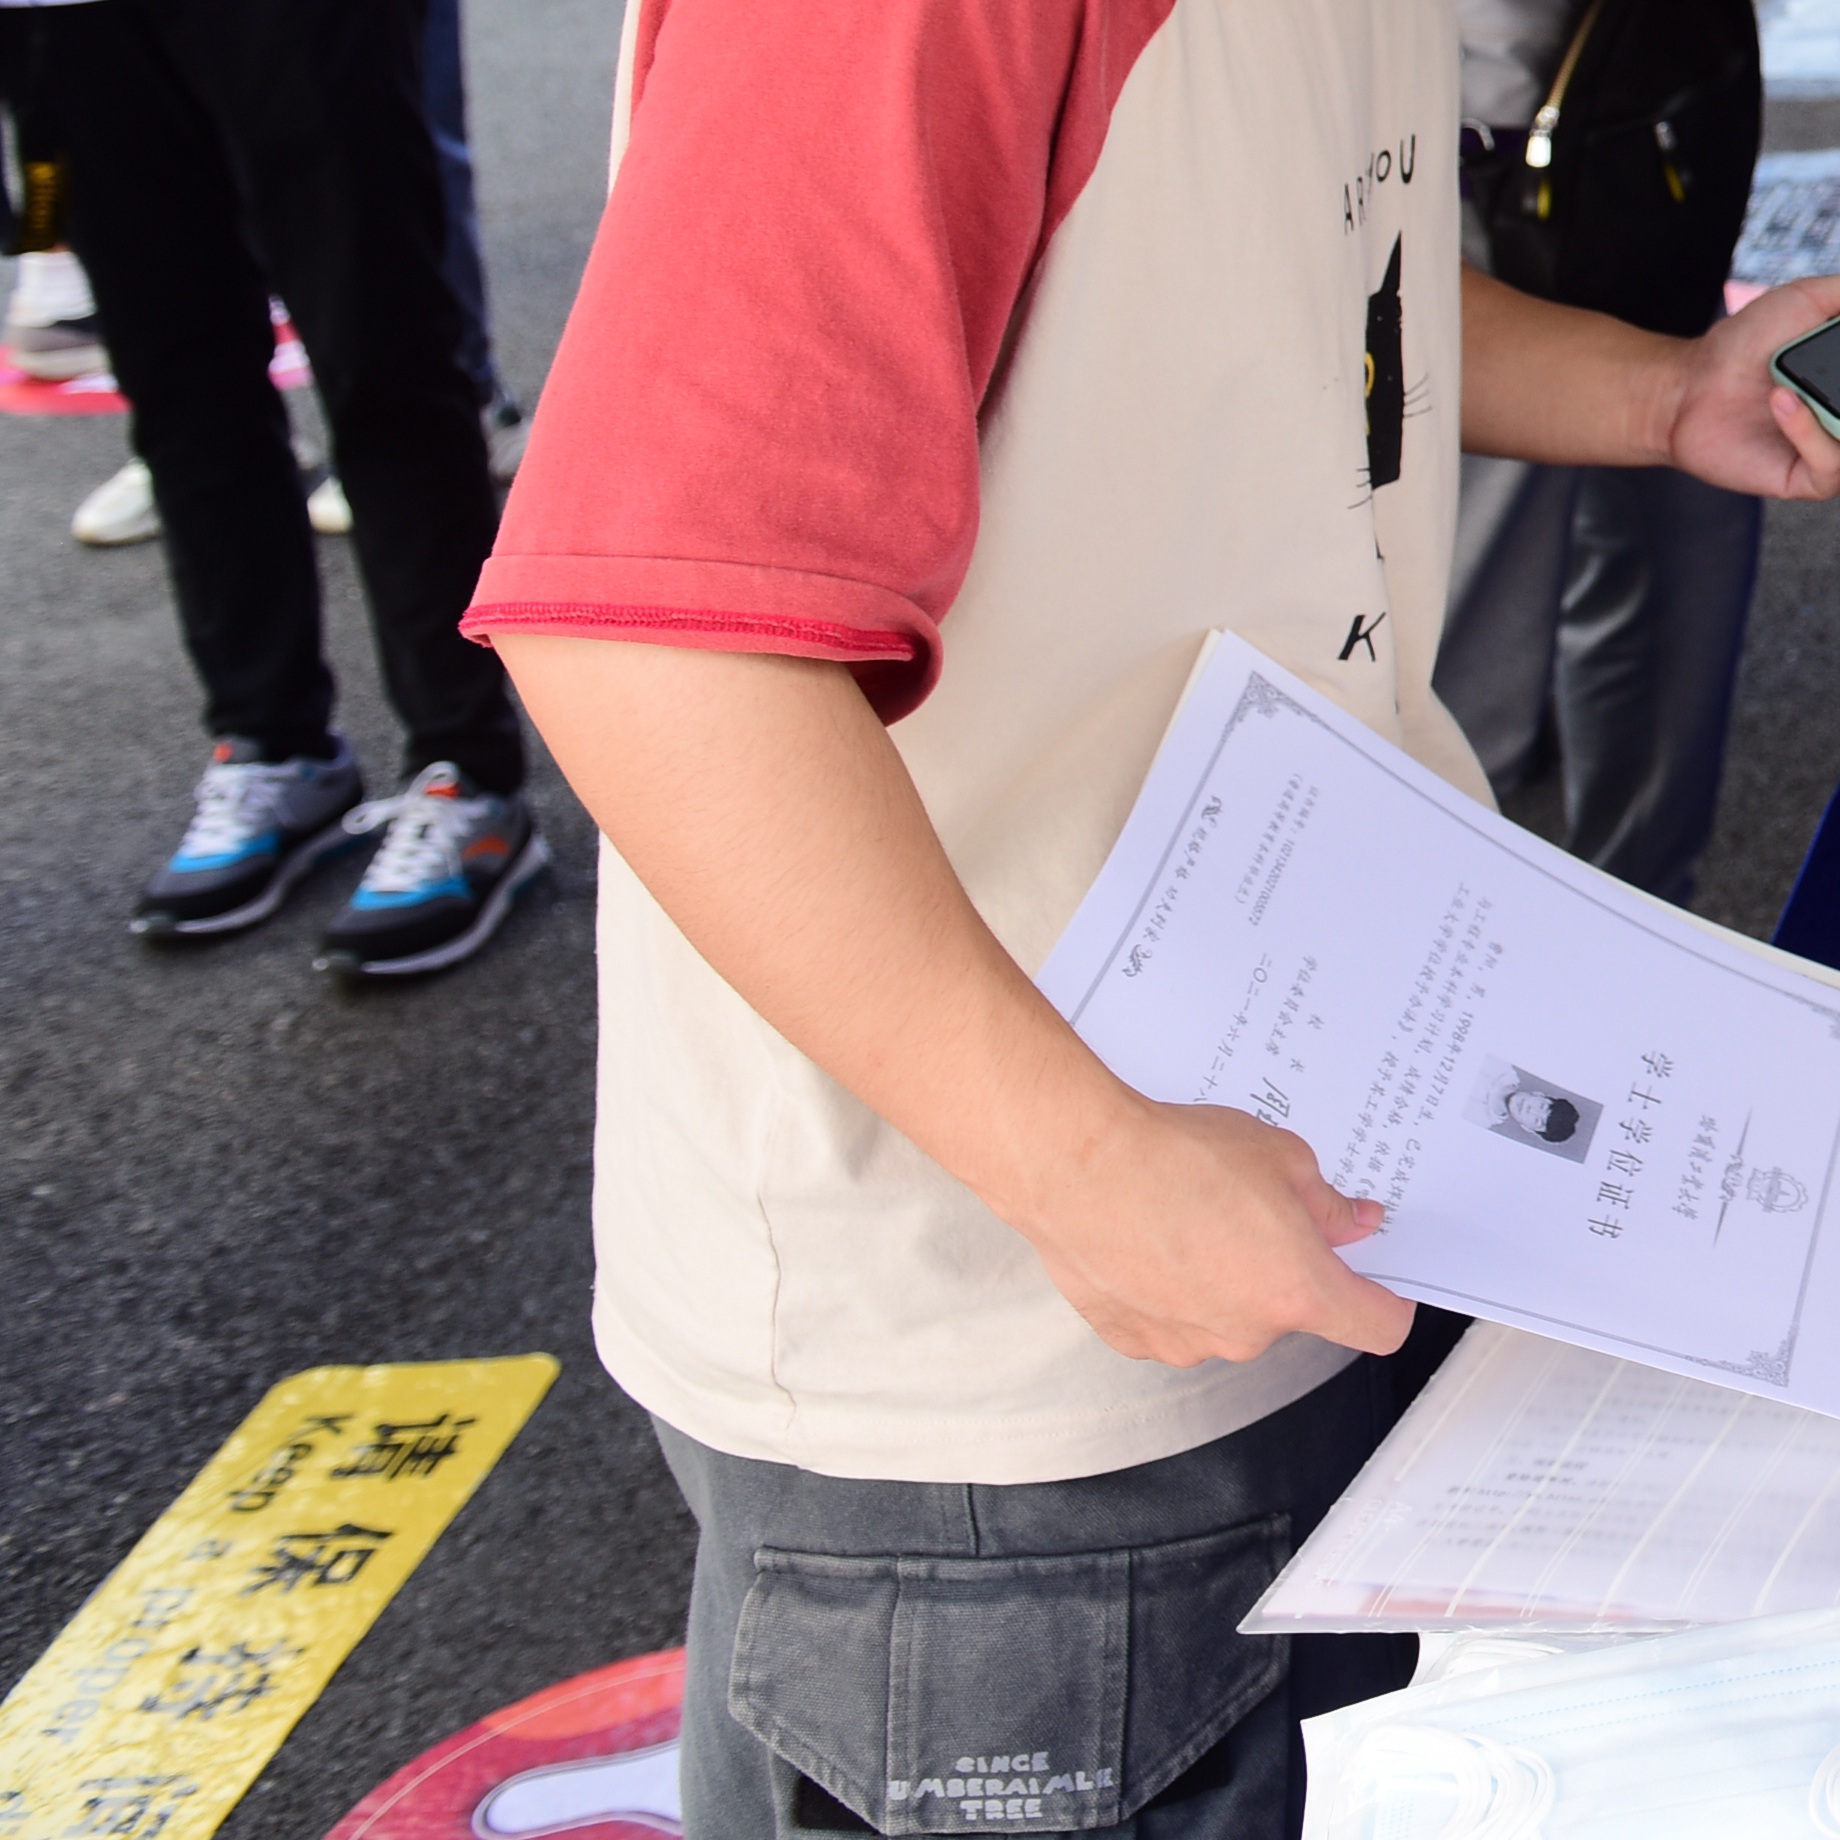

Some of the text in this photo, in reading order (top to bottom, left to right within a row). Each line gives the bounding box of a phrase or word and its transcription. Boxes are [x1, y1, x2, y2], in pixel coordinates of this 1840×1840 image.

[1585, 1054, 1675, 1238] 学士学位证书
[230, 1414, 353, 1514] Keep
[42, 1588, 196, 1745] proper
[955, 1751, 1050, 1774] SINCE
[959, 1798, 1043, 1821] TREE
